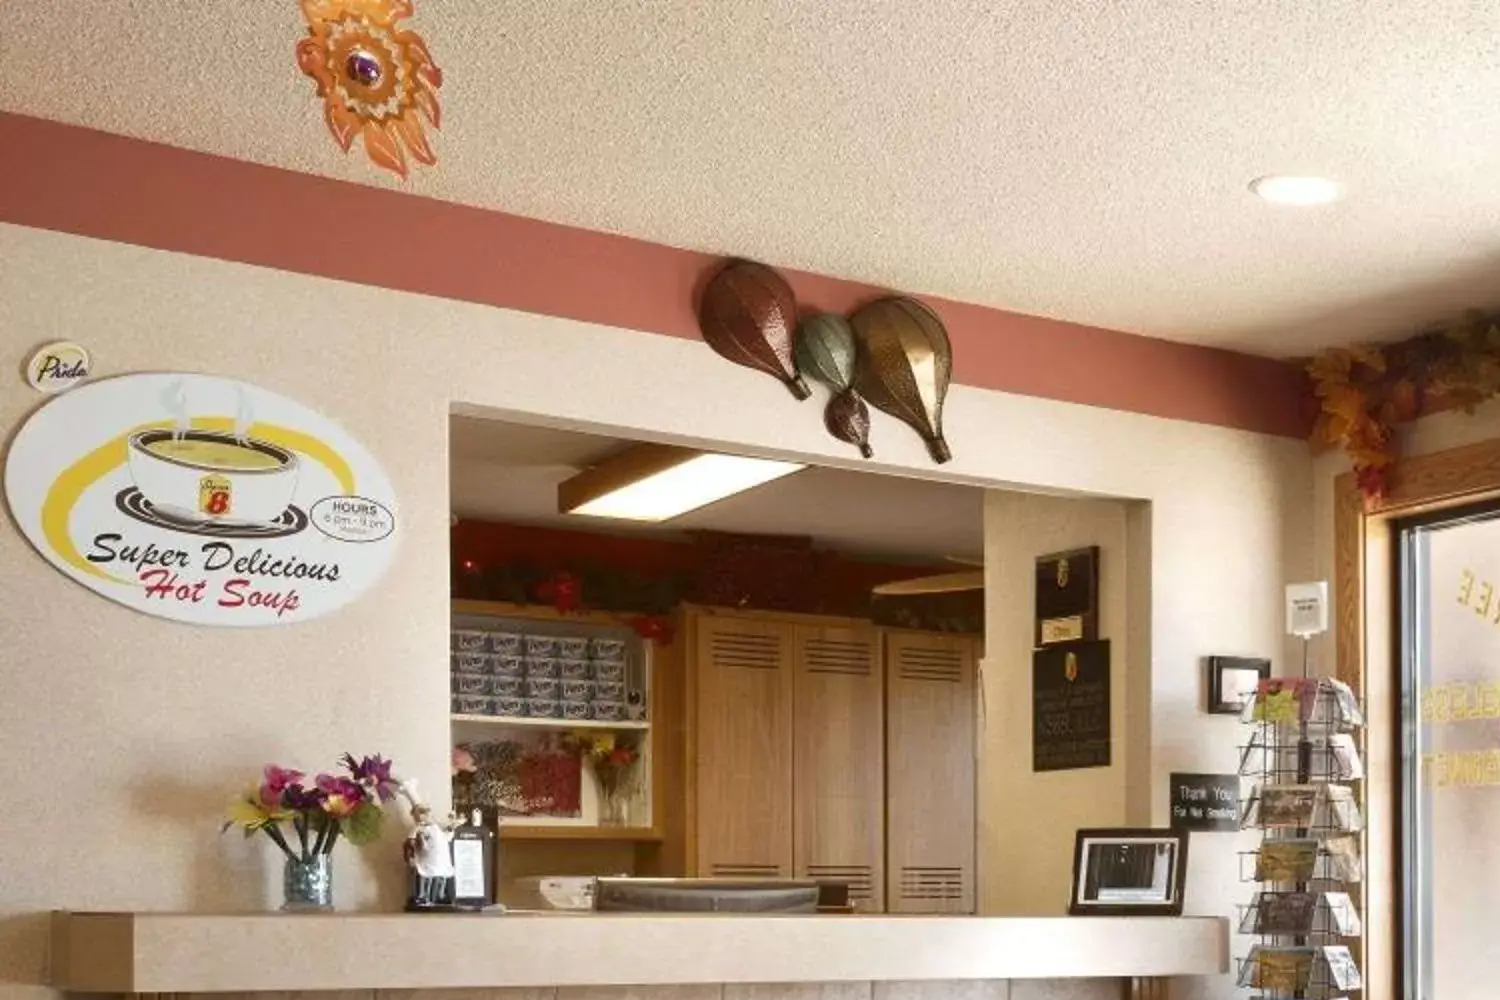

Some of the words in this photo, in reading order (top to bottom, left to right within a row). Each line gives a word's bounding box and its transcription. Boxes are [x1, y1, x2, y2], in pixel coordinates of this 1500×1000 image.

[36, 355, 88, 383] Pride
[333, 501, 377, 515] HOURS
[86, 533, 191, 572] Super
[201, 541, 342, 582] Delicious
[139, 569, 207, 604] Hot
[217, 579, 302, 617] Soup
